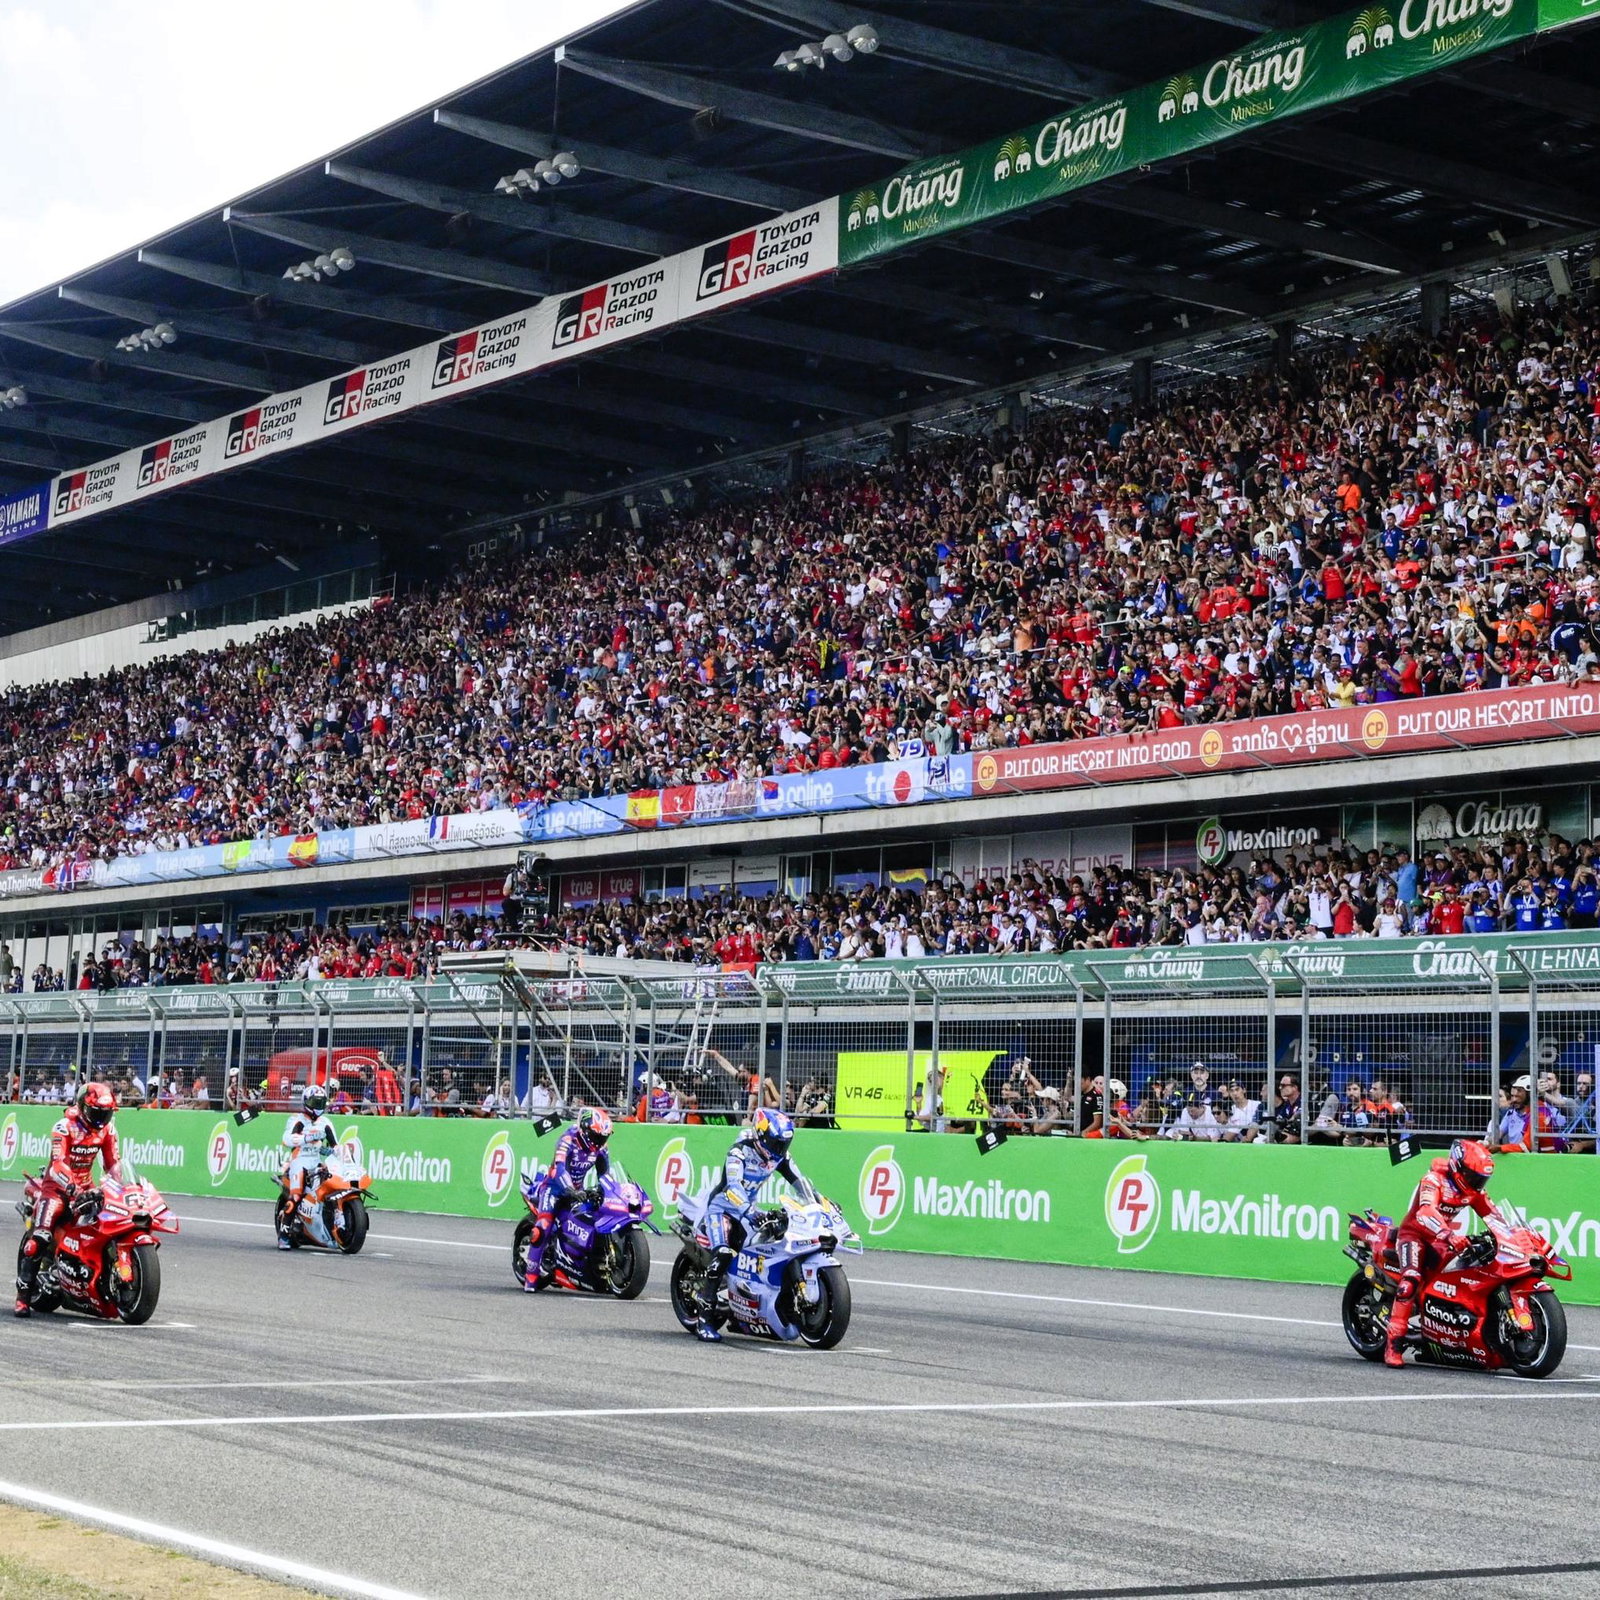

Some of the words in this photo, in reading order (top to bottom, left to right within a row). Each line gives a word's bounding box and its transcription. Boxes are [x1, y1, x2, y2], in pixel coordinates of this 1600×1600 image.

[1202, 45, 1306, 108] Chang
[1035, 106, 1127, 168] Chang
[882, 167, 964, 220] Chang
[760, 212, 820, 243] TOYOTA
[757, 232, 812, 262] GAZOO
[699, 253, 750, 298] GR
[754, 252, 809, 280] Racing
[611, 269, 664, 297] TOYOTA
[607, 289, 657, 314] GAZOO
[481, 318, 526, 343] TOYOTA
[554, 307, 602, 346] GR
[605, 307, 654, 331] Racing
[478, 336, 520, 358] GAZOO
[368, 358, 411, 381] TOYOTA
[434, 352, 474, 387] GR
[475, 353, 516, 375] Racing
[365, 375, 405, 396] GAZOO
[263, 396, 302, 418] TOYOTA
[325, 389, 362, 424] GR
[362, 391, 401, 412] Racing
[260, 412, 296, 432] GAZOO
[173, 430, 206, 450] TOYOTA
[227, 426, 257, 457] GR
[258, 427, 293, 447] Racing
[168, 459, 199, 476] Racing
[170, 445, 202, 463] GAZOO
[86, 476, 115, 494] GAZOO
[88, 462, 120, 480] TOYOTA
[139, 457, 168, 487] GR
[6, 494, 40, 525] YAMAHA
[56, 487, 83, 516] GR
[83, 490, 113, 507] Racing
[1398, 711, 1432, 735] PUT
[1435, 708, 1471, 731] OUR
[1550, 694, 1593, 719] INTO
[1366, 720, 1384, 738] CP
[900, 740, 922, 758] 79
[1004, 759, 1029, 778] PUT
[1031, 755, 1058, 776] OUR
[1117, 745, 1149, 767] INTO
[1153, 740, 1191, 762] FOOD
[1203, 739, 1218, 755] CP
[981, 766, 995, 780] CP
[786, 778, 833, 809] online
[7, 872, 42, 893] Thailand
[570, 879, 593, 897] true
[610, 873, 633, 894] true
[1413, 941, 1499, 982] Chang
[836, 963, 891, 996] Chang
[5, 1127, 16, 1158] PT
[122, 1136, 184, 1167] Maxnitron
[214, 1136, 227, 1172] PT
[369, 1149, 451, 1183] Maxnitron
[490, 1150, 508, 1190] PT
[664, 1158, 685, 1202] PT
[870, 1167, 895, 1217] PT
[913, 1175, 1051, 1223] Maxnitron
[1438, 1202, 1464, 1214] Len
[105, 1203, 129, 1216] Lenovo
[1118, 1178, 1149, 1233] PT
[1172, 1188, 1339, 1242] Maxnitron
[1425, 1300, 1471, 1326] Lenovo
